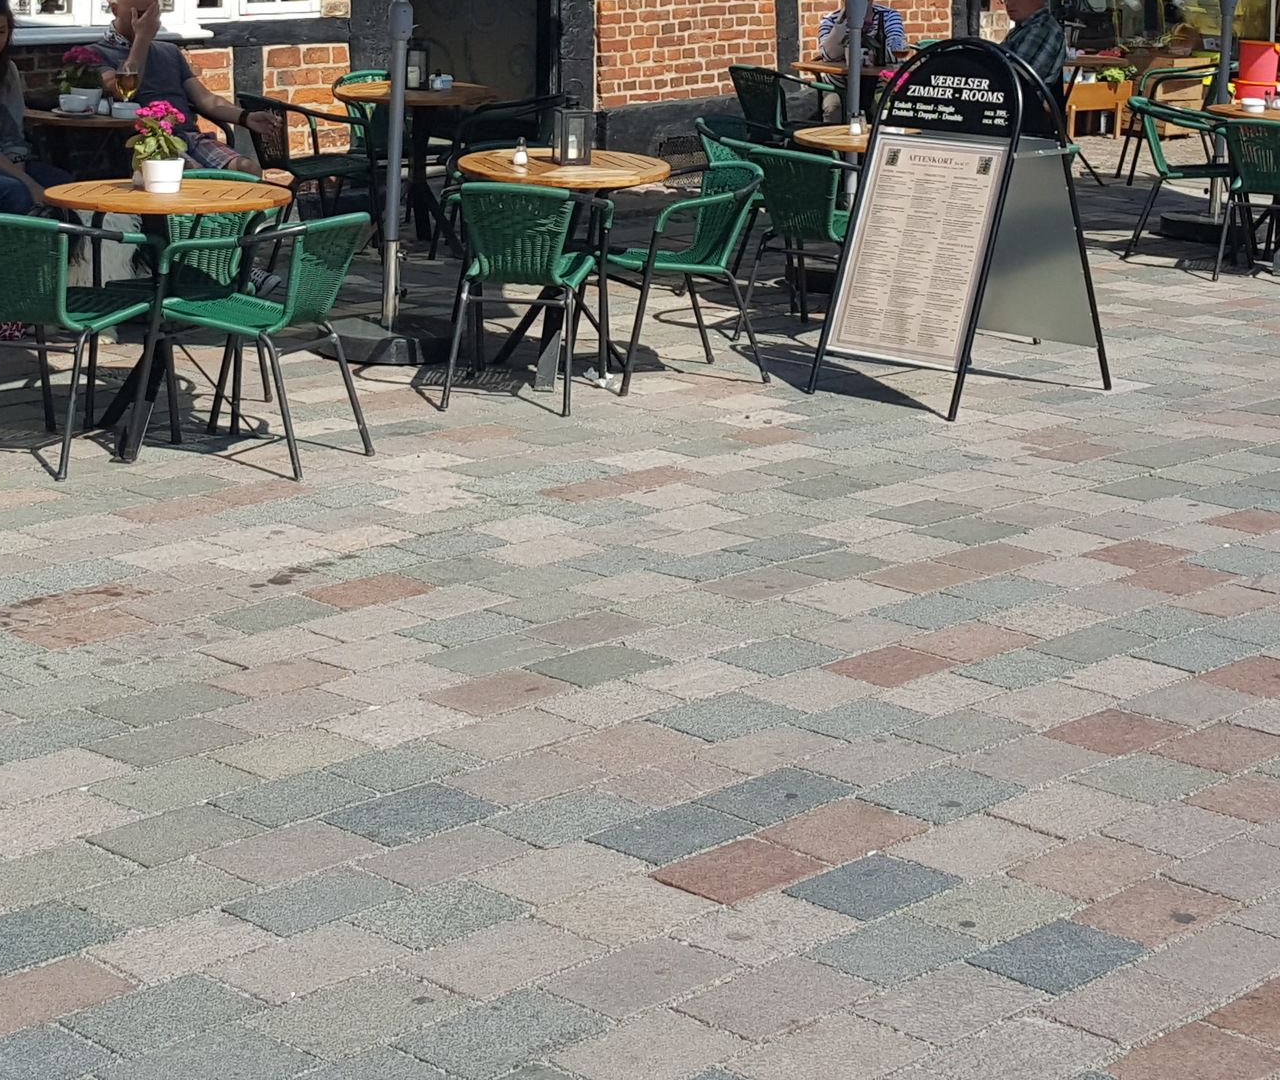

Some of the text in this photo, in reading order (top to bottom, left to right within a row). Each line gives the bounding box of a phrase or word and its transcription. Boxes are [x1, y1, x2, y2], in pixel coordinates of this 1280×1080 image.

[930, 75, 990, 90] VÆRELSER
[906, 85, 953, 99] ZIMMER
[960, 90, 1004, 103] ROOMS
